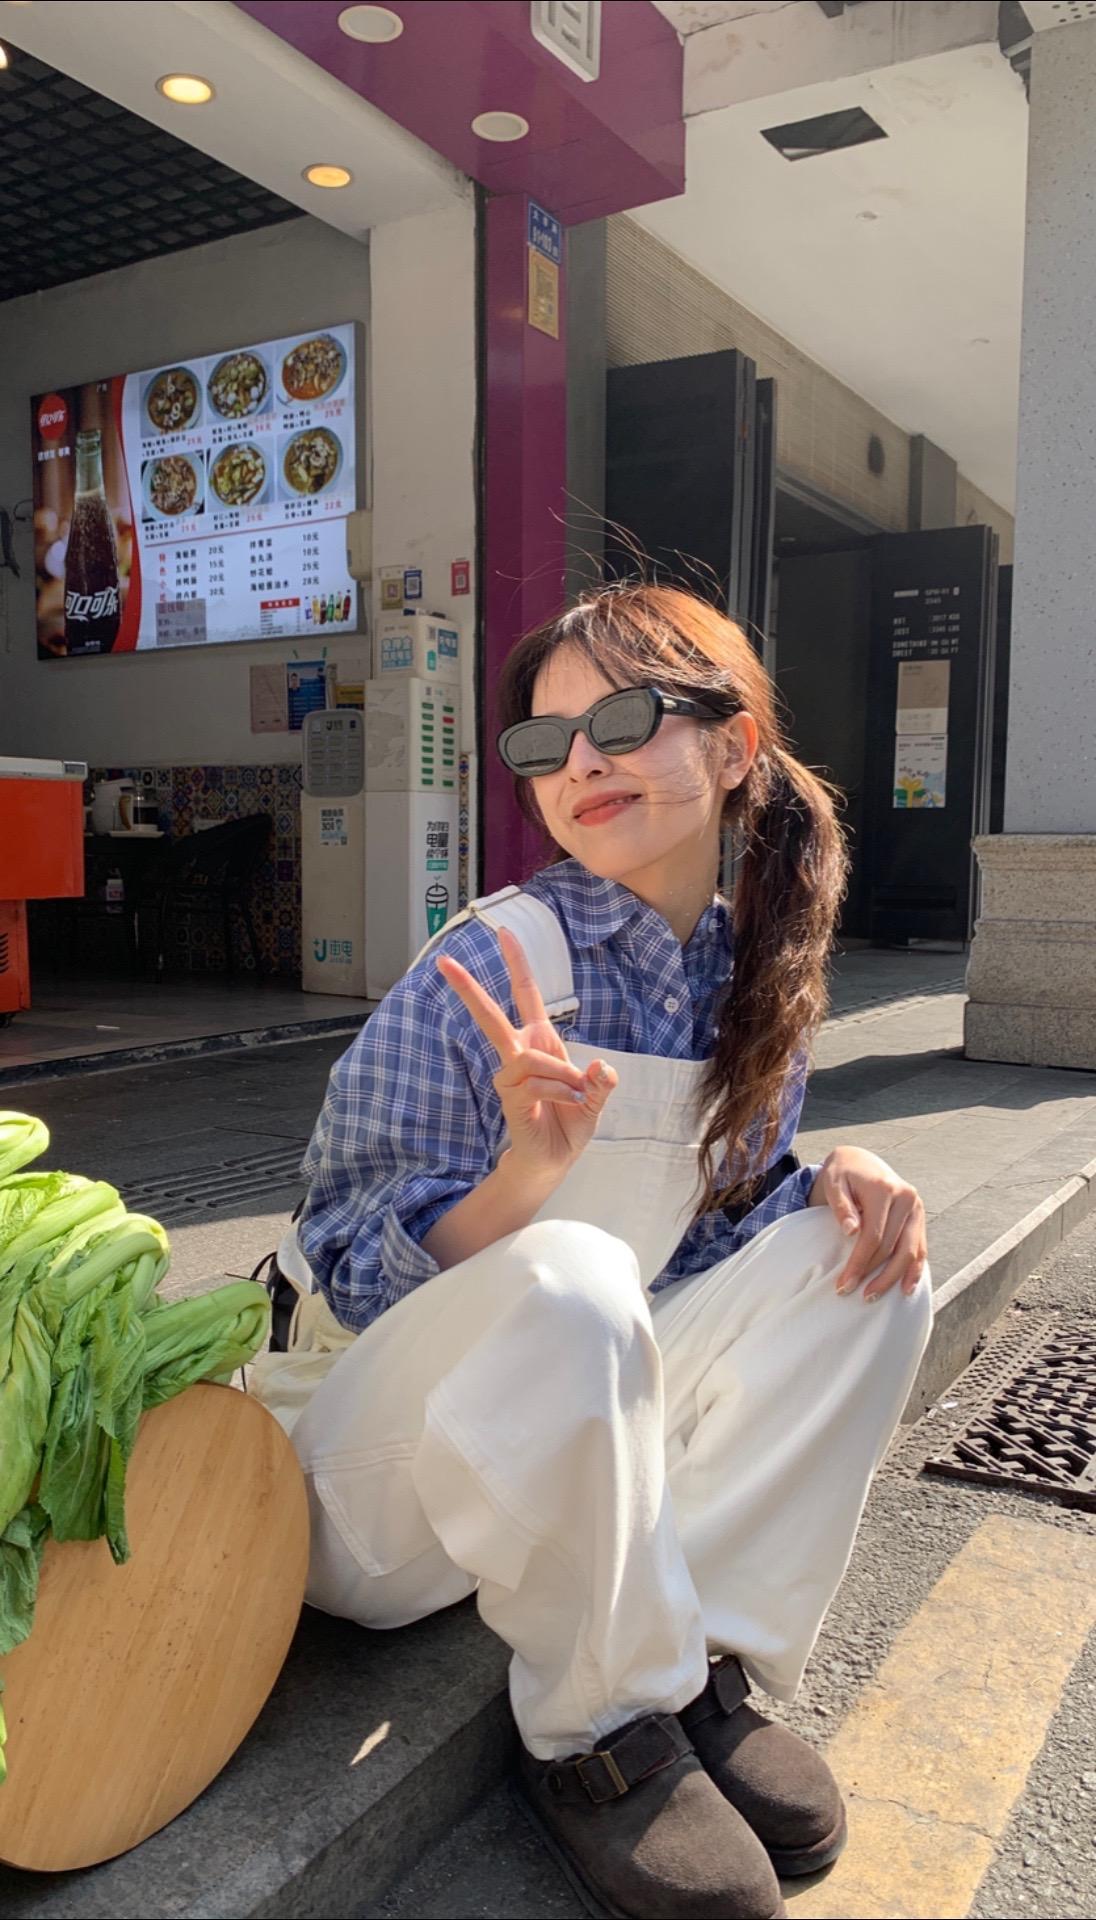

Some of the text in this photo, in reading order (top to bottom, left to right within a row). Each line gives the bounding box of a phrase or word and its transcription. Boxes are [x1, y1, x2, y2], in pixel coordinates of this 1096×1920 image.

[65, 582, 120, 622] 可口可乐
[426, 833, 449, 847] 电量
